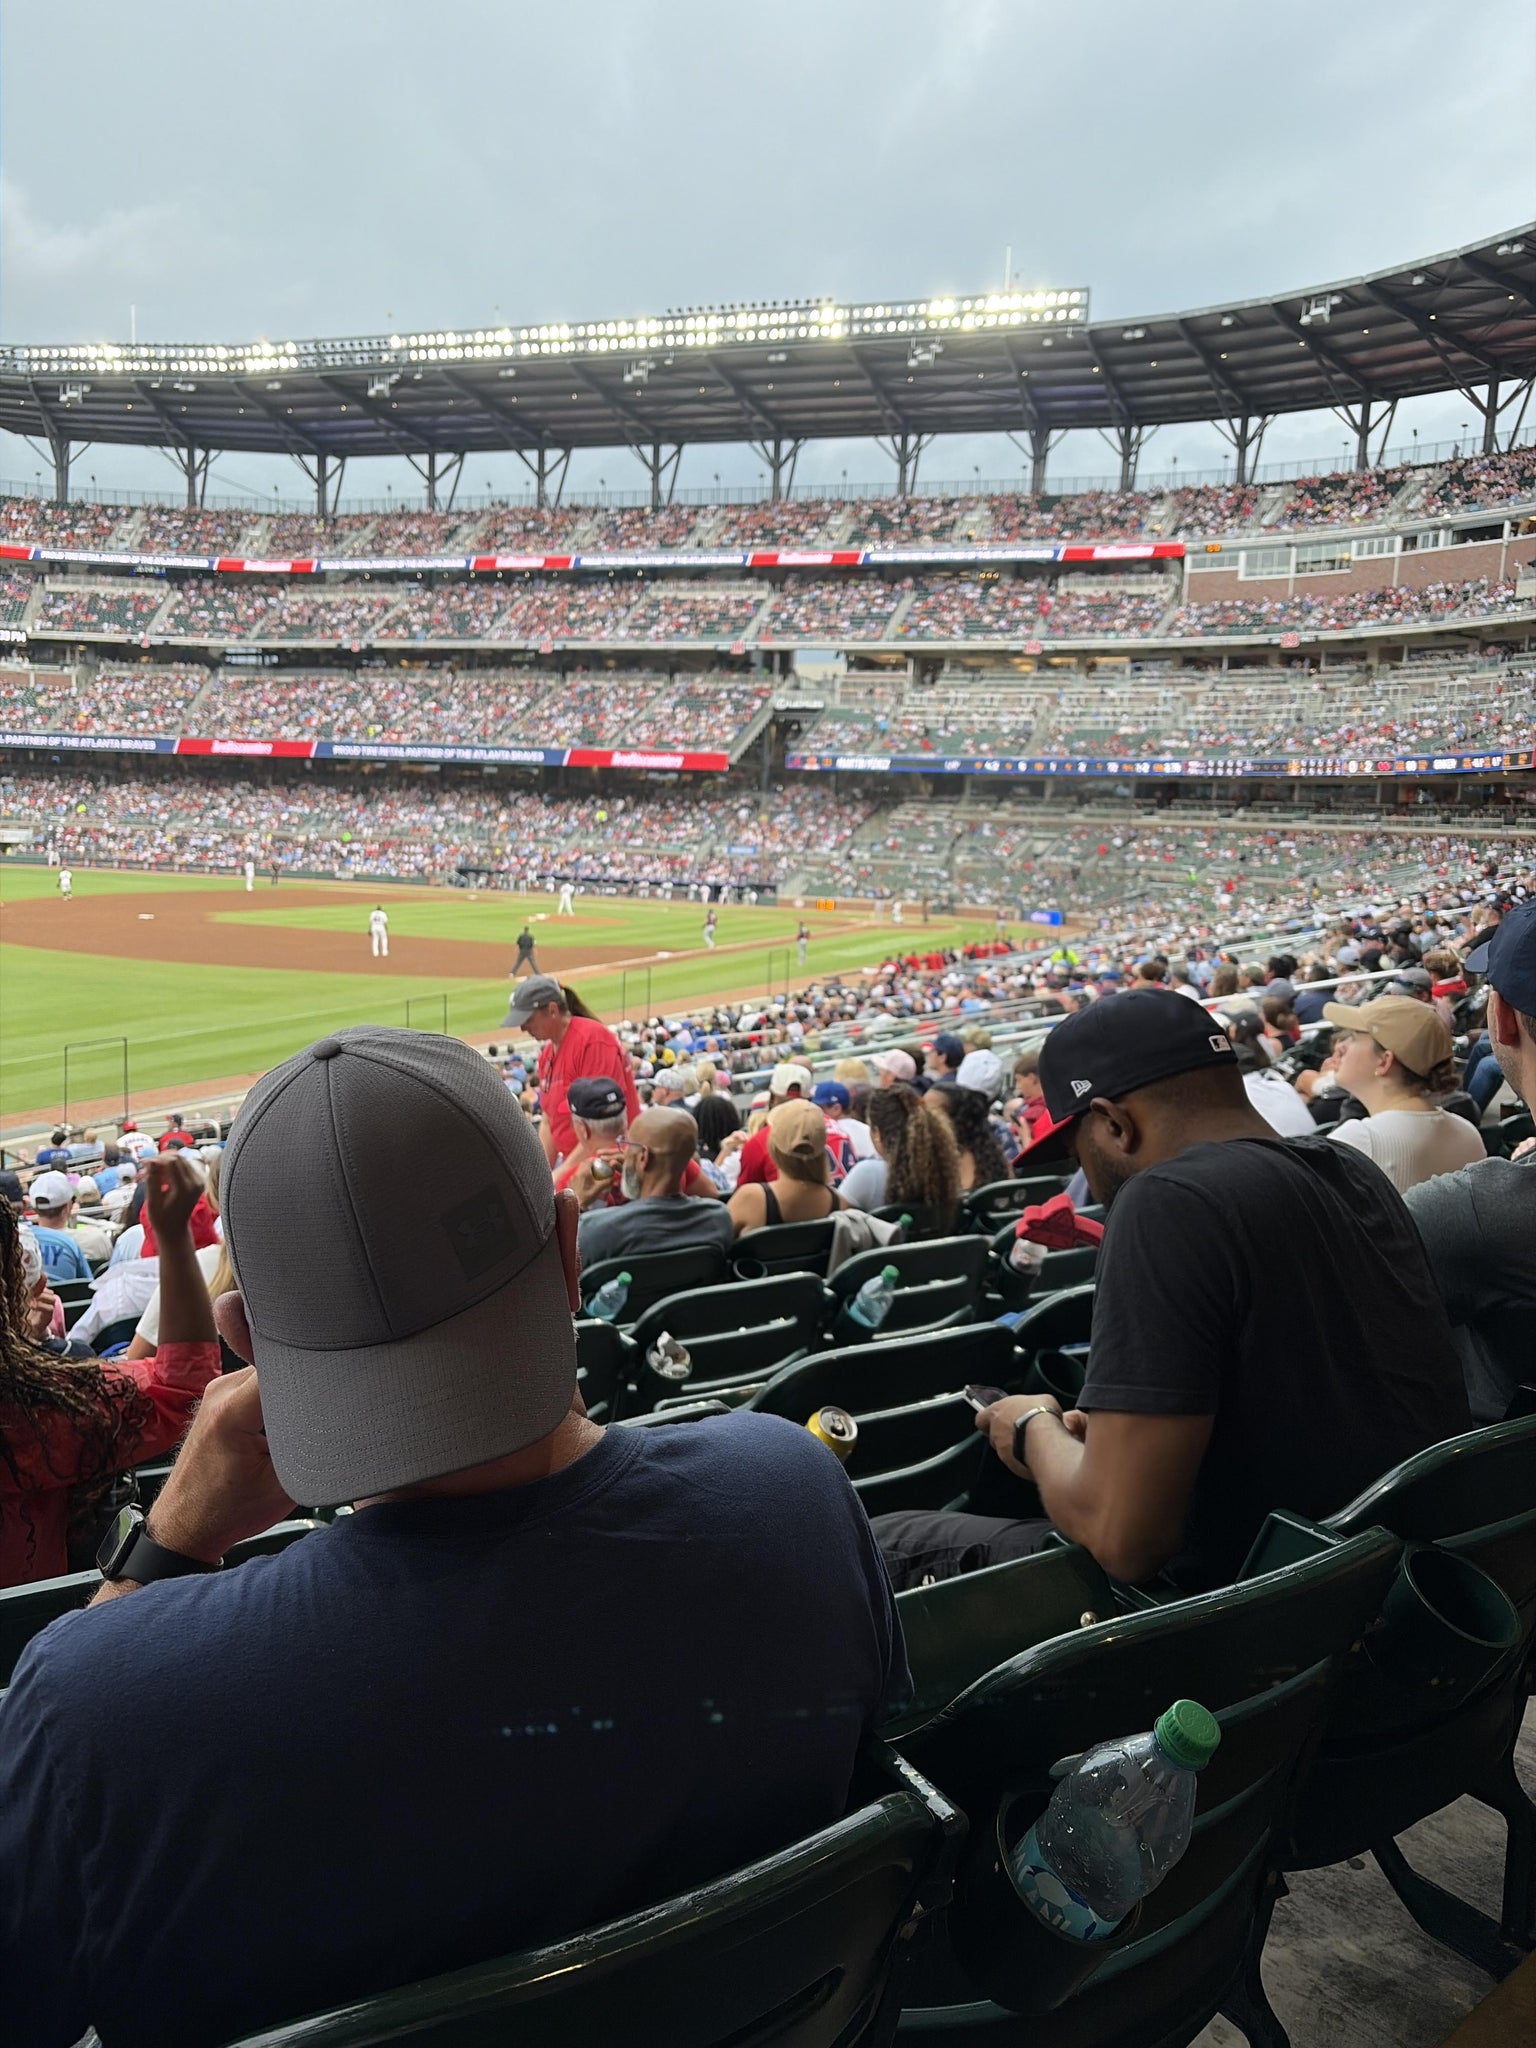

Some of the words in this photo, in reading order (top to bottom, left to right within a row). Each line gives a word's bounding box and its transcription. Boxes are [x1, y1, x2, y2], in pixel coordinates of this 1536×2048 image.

[5, 734, 47, 746] PARTNER
[48, 736, 61, 746] OF
[62, 737, 80, 747] THE
[80, 737, 120, 749] ATLANTA
[121, 739, 156, 750] BRAVES
[473, 749, 511, 761] ATLANTA
